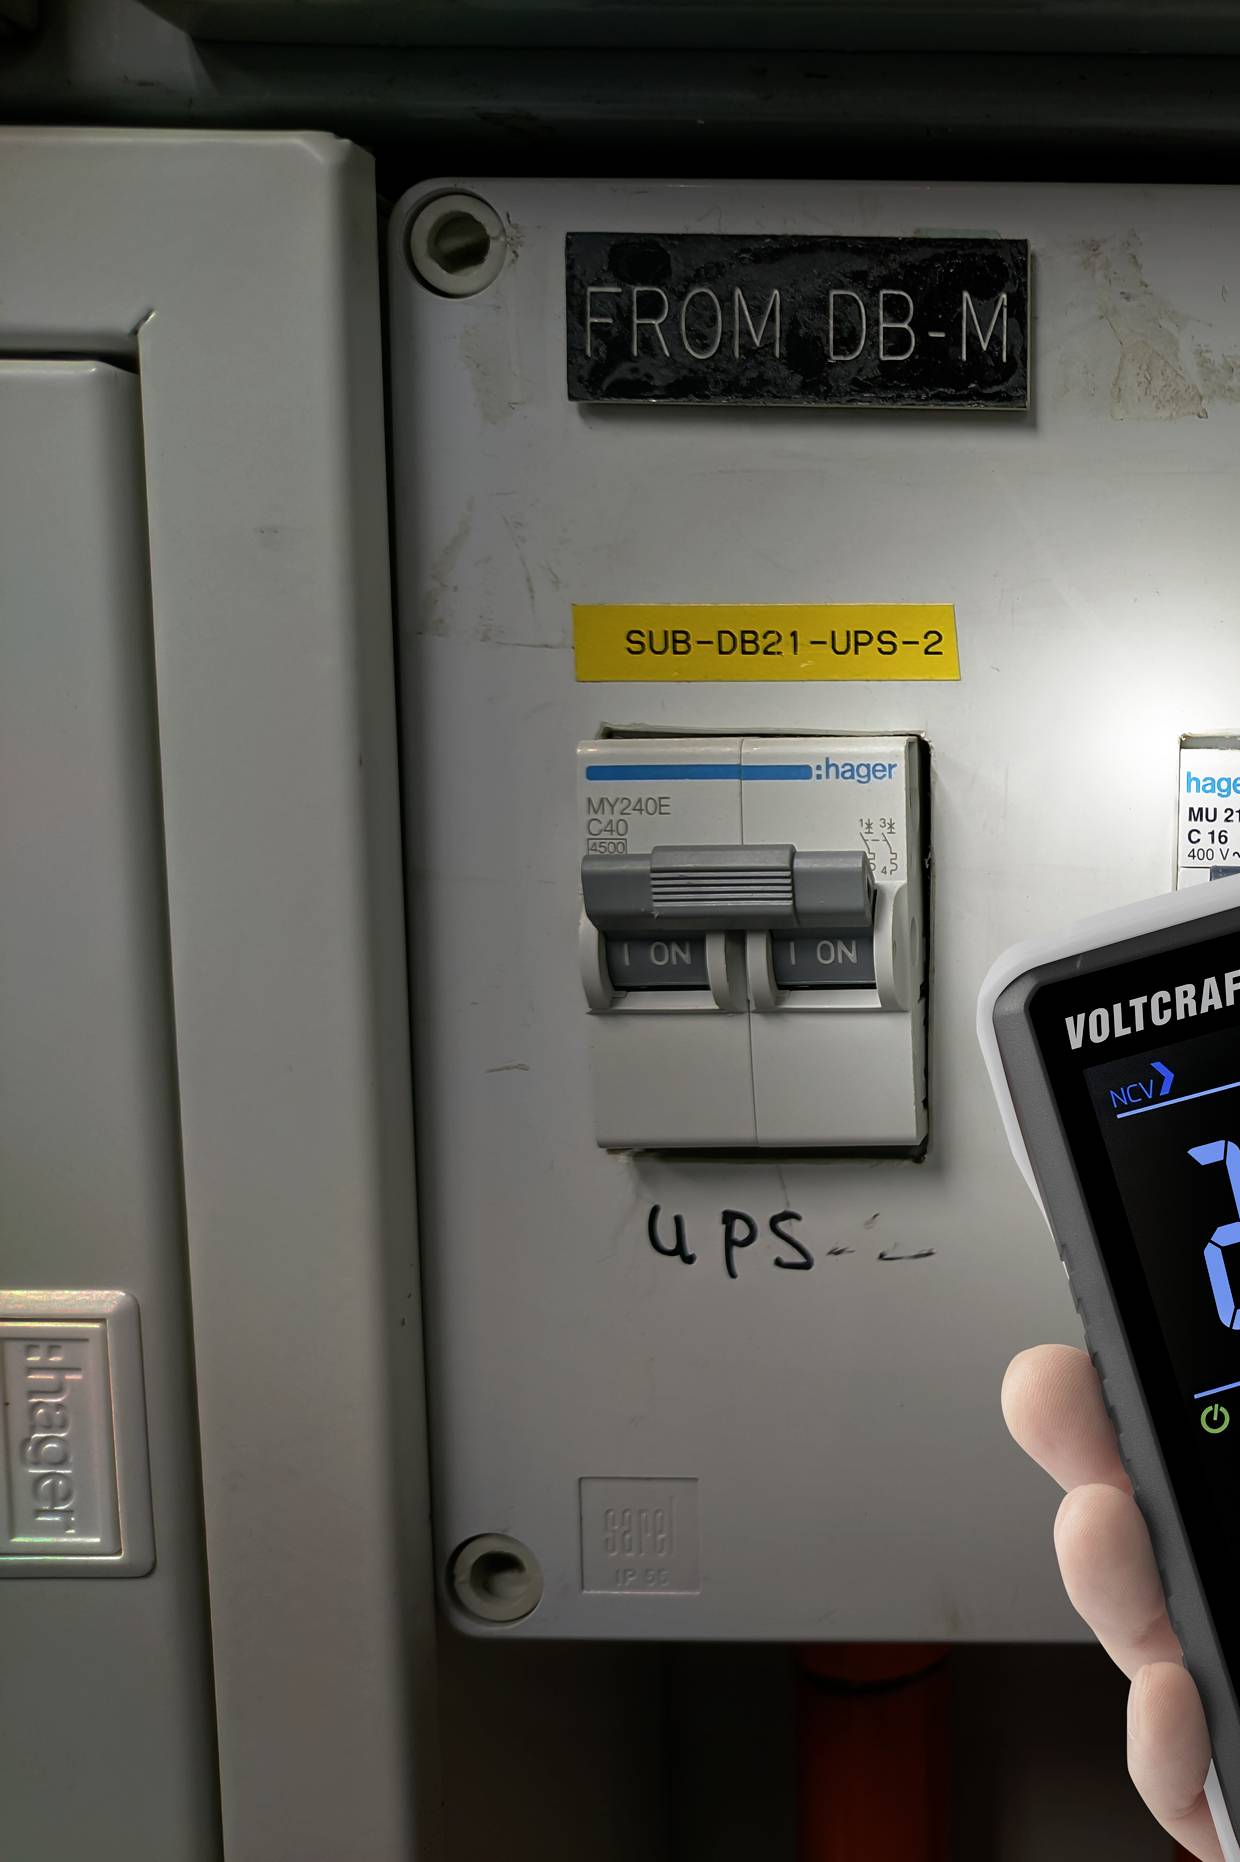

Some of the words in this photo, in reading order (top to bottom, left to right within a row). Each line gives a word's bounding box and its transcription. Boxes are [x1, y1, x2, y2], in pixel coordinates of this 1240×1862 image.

[585, 286, 782, 360] FROM
[828, 288, 1008, 363] DB-M
[625, 628, 944, 657] SUB-DB21-UPS-2
[586, 796, 672, 817] MY240E
[1187, 807, 1218, 824] MU
[587, 818, 629, 838] C40
[1187, 830, 1201, 845] C
[1208, 830, 1228, 845] 16
[589, 841, 626, 854] 4500
[1187, 848, 1215, 862] 400
[650, 941, 691, 966] ON
[816, 940, 857, 965] ON
[1109, 1079, 1154, 1108] NCV
